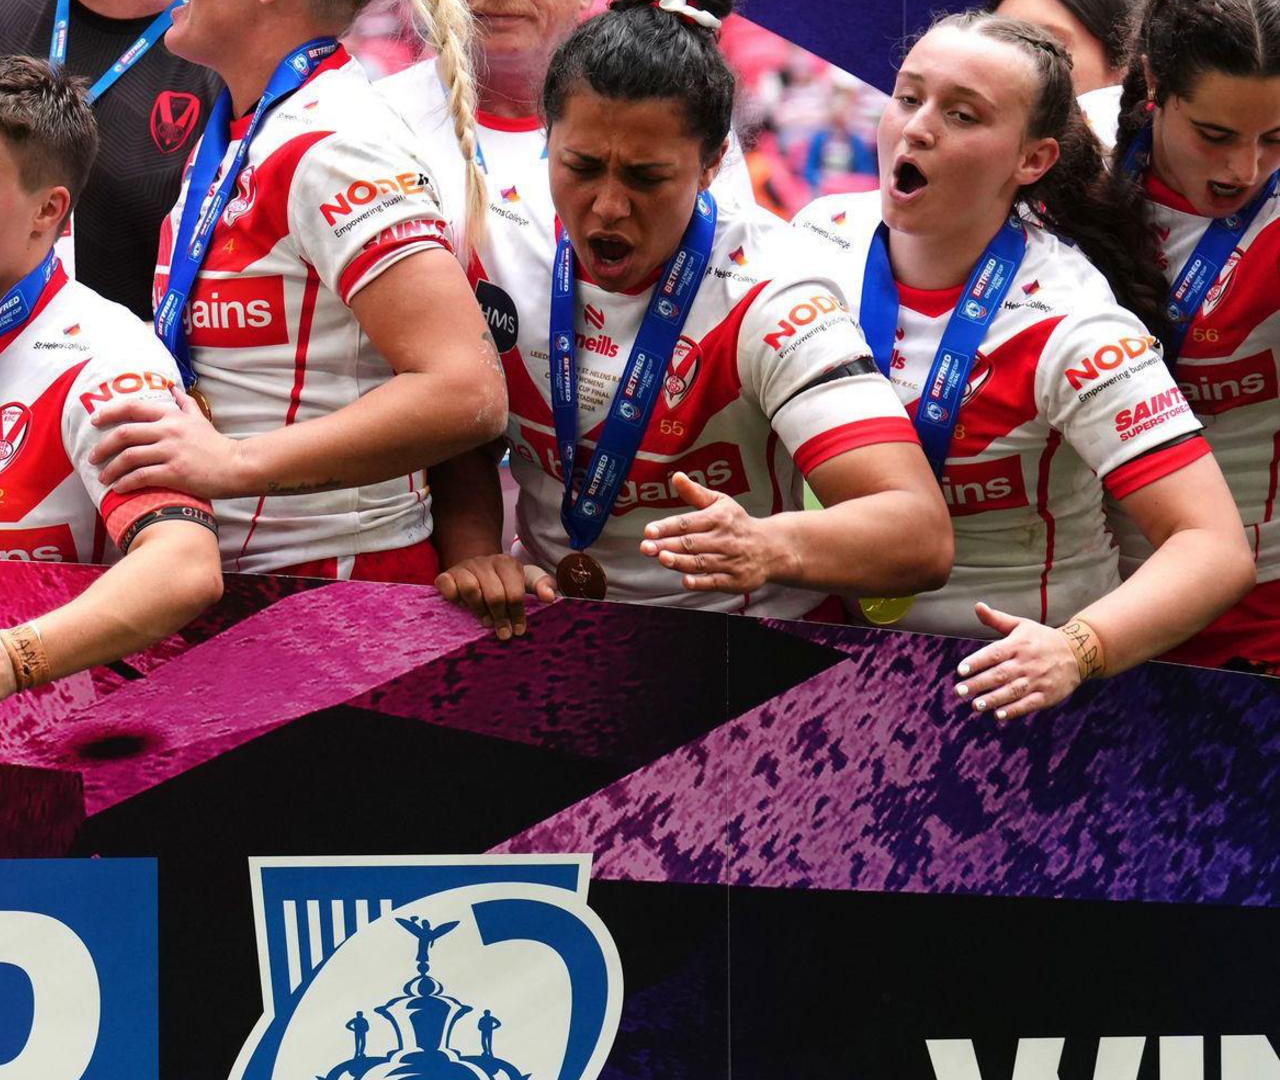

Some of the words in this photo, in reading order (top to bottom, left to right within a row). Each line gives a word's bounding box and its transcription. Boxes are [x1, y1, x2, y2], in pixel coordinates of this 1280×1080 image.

[334, 197, 384, 238] Empowering
[665, 250, 688, 295] BETFRED
[973, 258, 997, 297] BETFRED
[1175, 259, 1202, 299] BETFRED
[158, 294, 175, 335] BETFRED
[1192, 328, 1220, 343] 56
[79, 371, 176, 415] NOD
[563, 356, 571, 402] BETFRED
[625, 353, 646, 397] BETFRED
[931, 354, 952, 398] BETFRED
[1078, 369, 1132, 404] Empowering
[659, 420, 685, 436] 55
[587, 454, 609, 496] BETFRED
